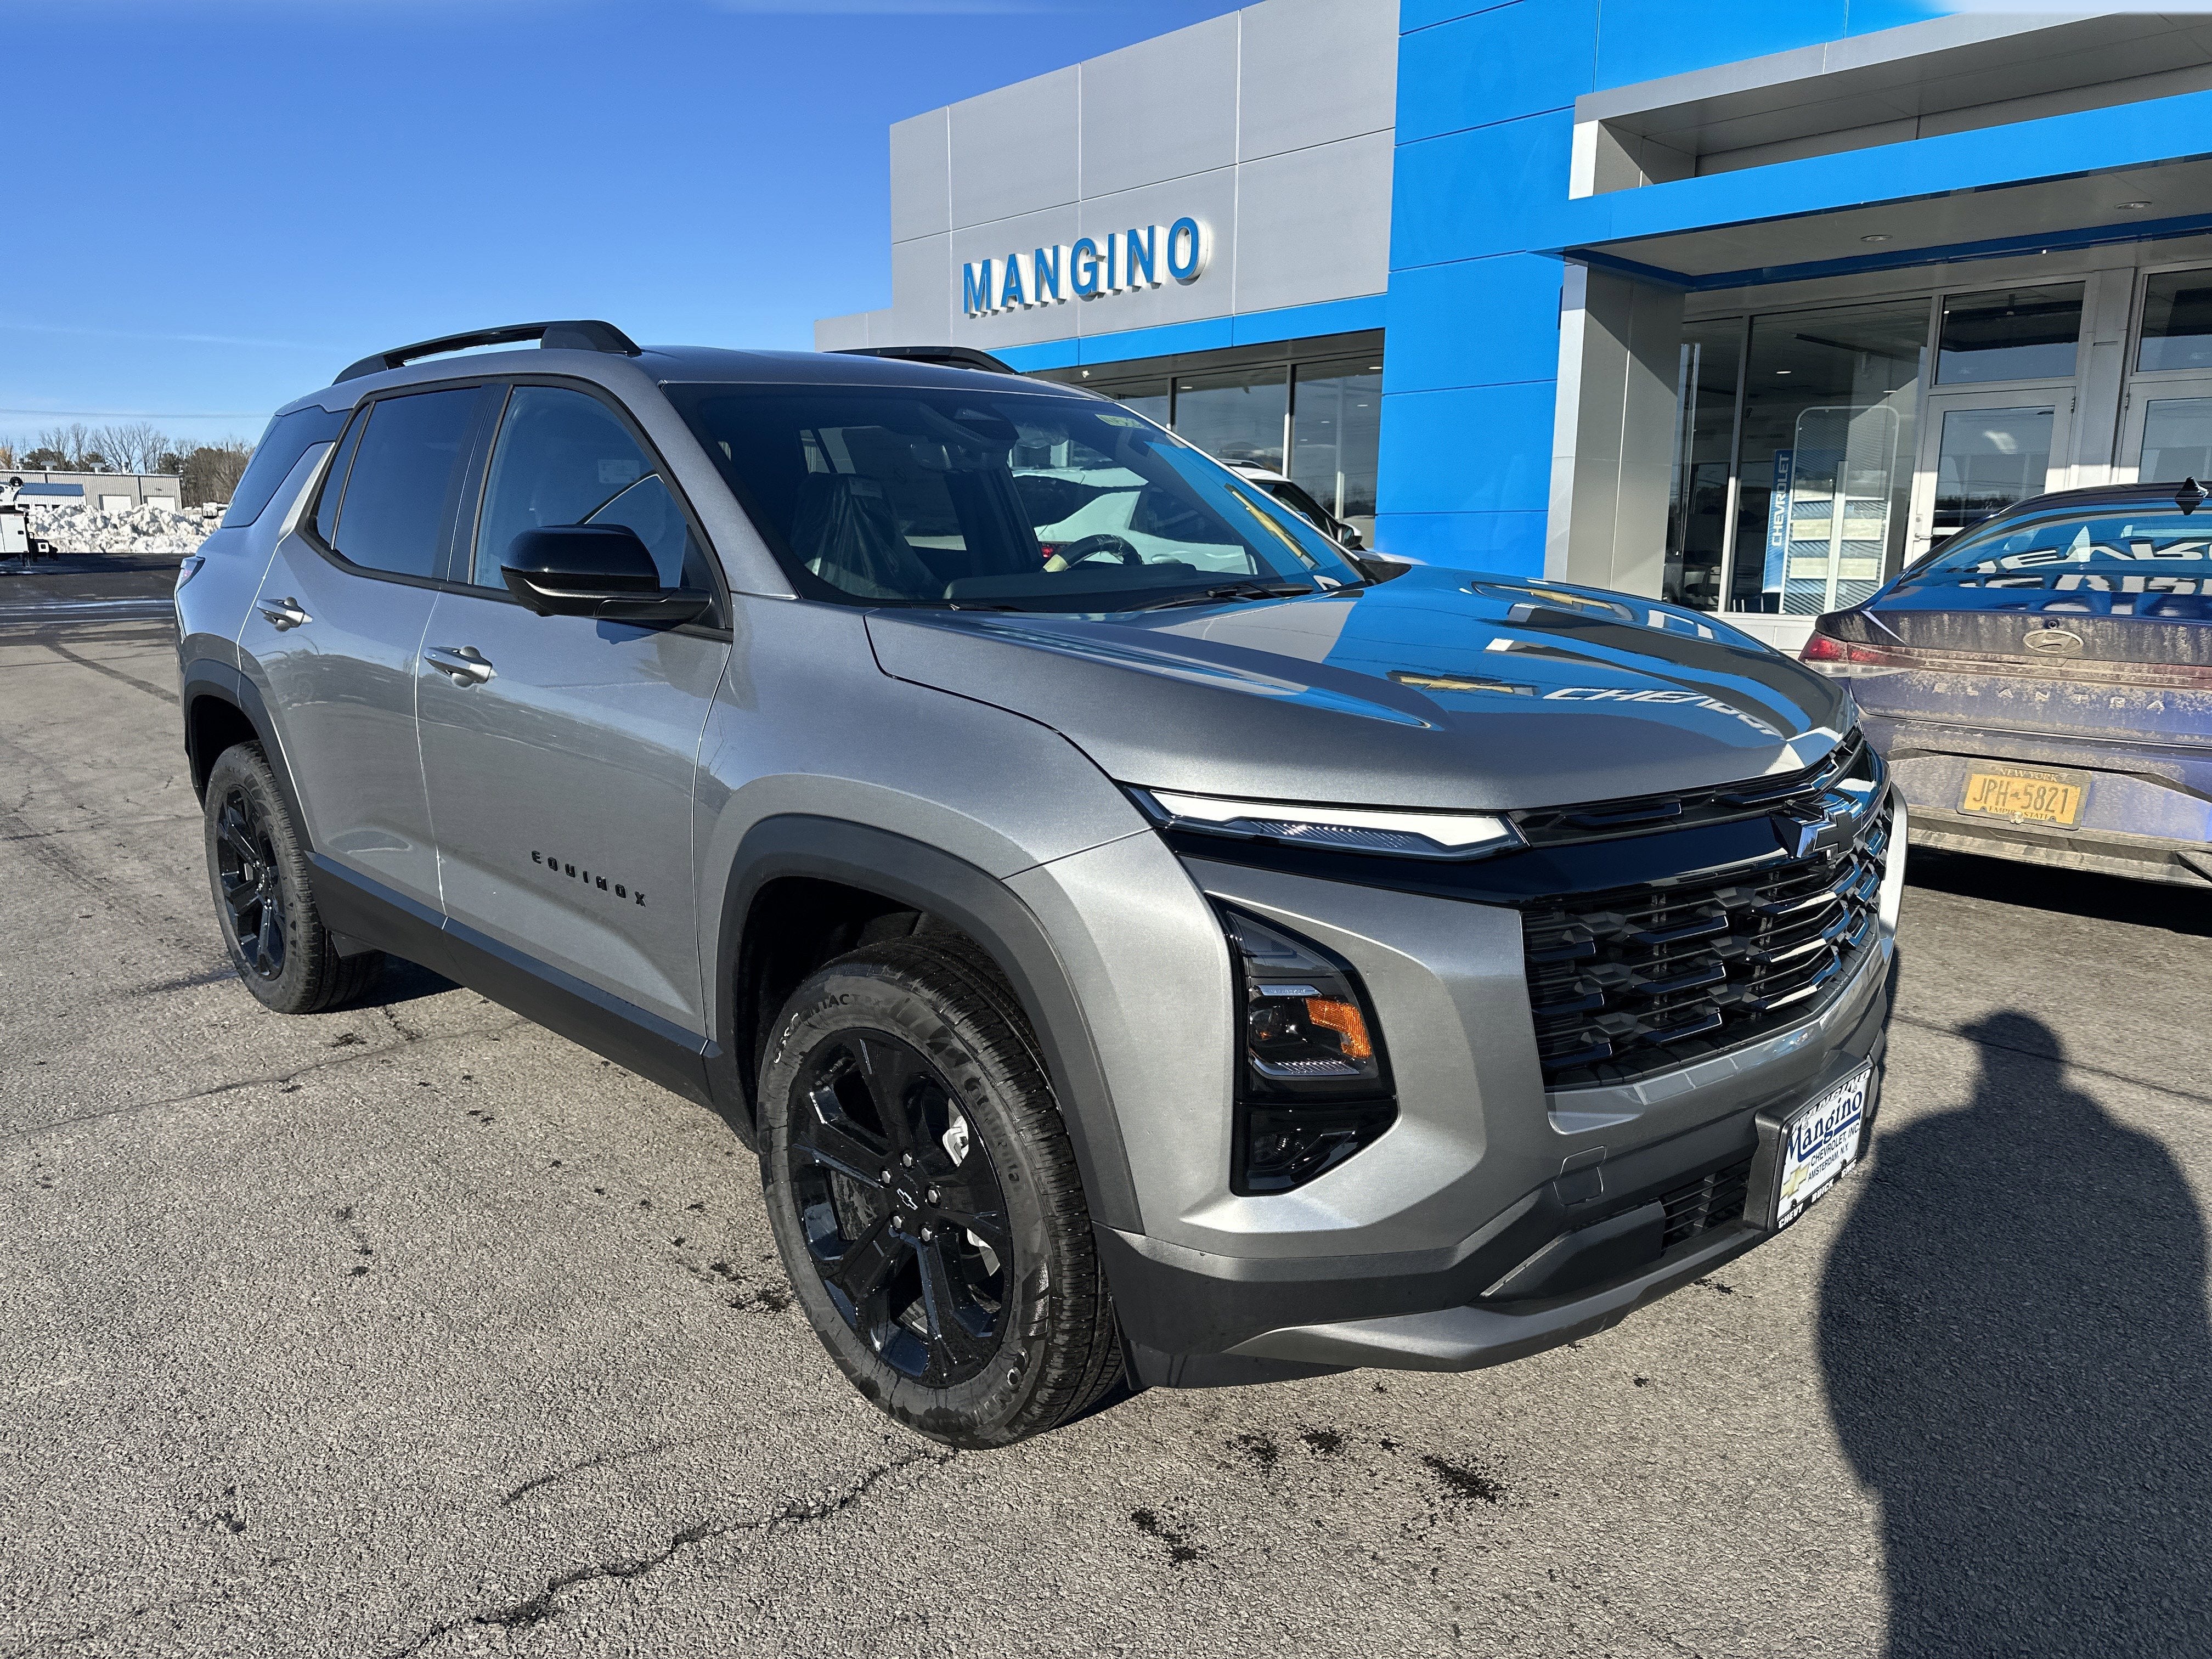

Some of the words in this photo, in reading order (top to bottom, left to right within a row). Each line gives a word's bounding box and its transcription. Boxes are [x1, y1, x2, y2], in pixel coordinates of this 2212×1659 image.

[962, 217, 1205, 315] MANGINO
[1771, 454, 1789, 547] CHEVROLET
[1932, 682, 2165, 710] ELANTRA
[1999, 768, 2025, 777] NEW
[2029, 771, 2058, 782] YORK
[1989, 806, 2019, 816] EMPIR
[531, 850, 646, 907] EQUINOX
[1787, 1091, 1863, 1163] Mangino
[1778, 1203, 1804, 1229] CHEVY
[1811, 1178, 1835, 1203] BUICK
